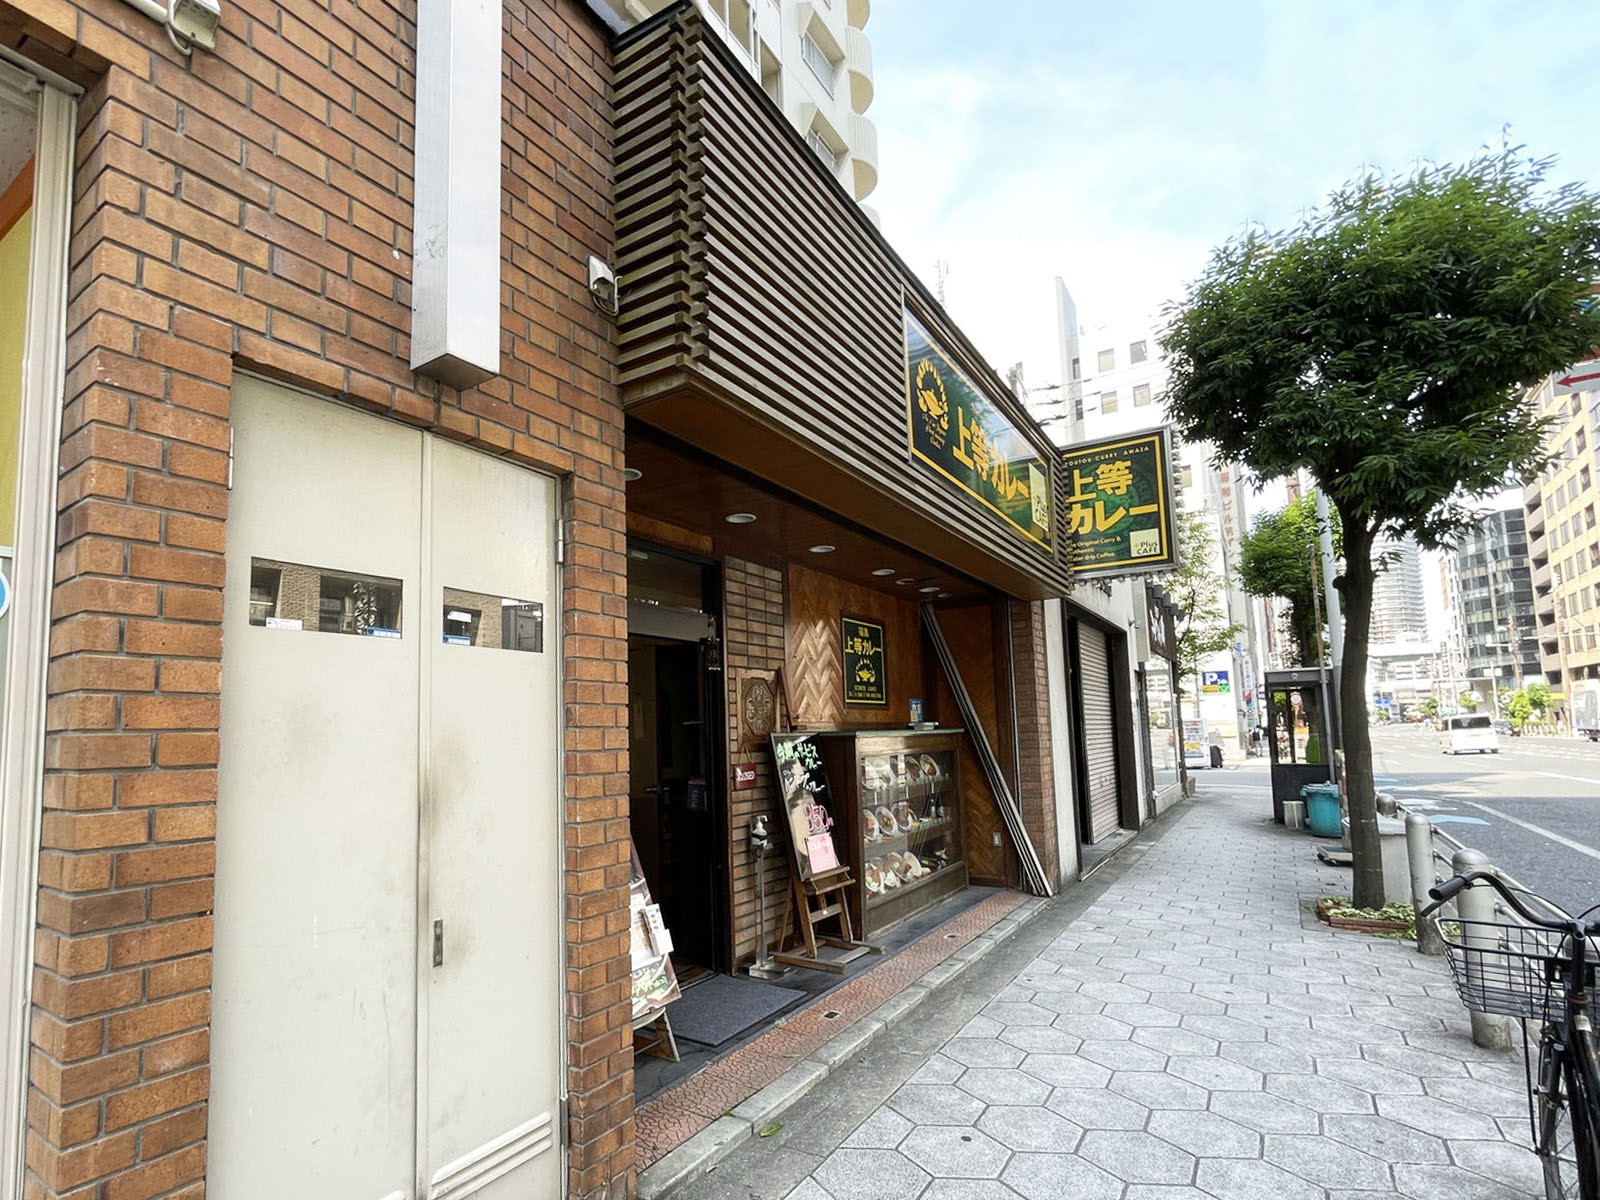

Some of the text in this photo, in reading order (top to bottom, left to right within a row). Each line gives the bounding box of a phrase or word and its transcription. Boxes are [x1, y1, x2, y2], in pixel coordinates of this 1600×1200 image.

[952, 405, 1030, 501] 上等カレー
[1123, 446, 1150, 456] AWAZA
[1065, 460, 1133, 503] 上等
[1066, 500, 1159, 535] カレー
[1140, 540, 1158, 548] Plus
[845, 636, 882, 656] 上等カレー
